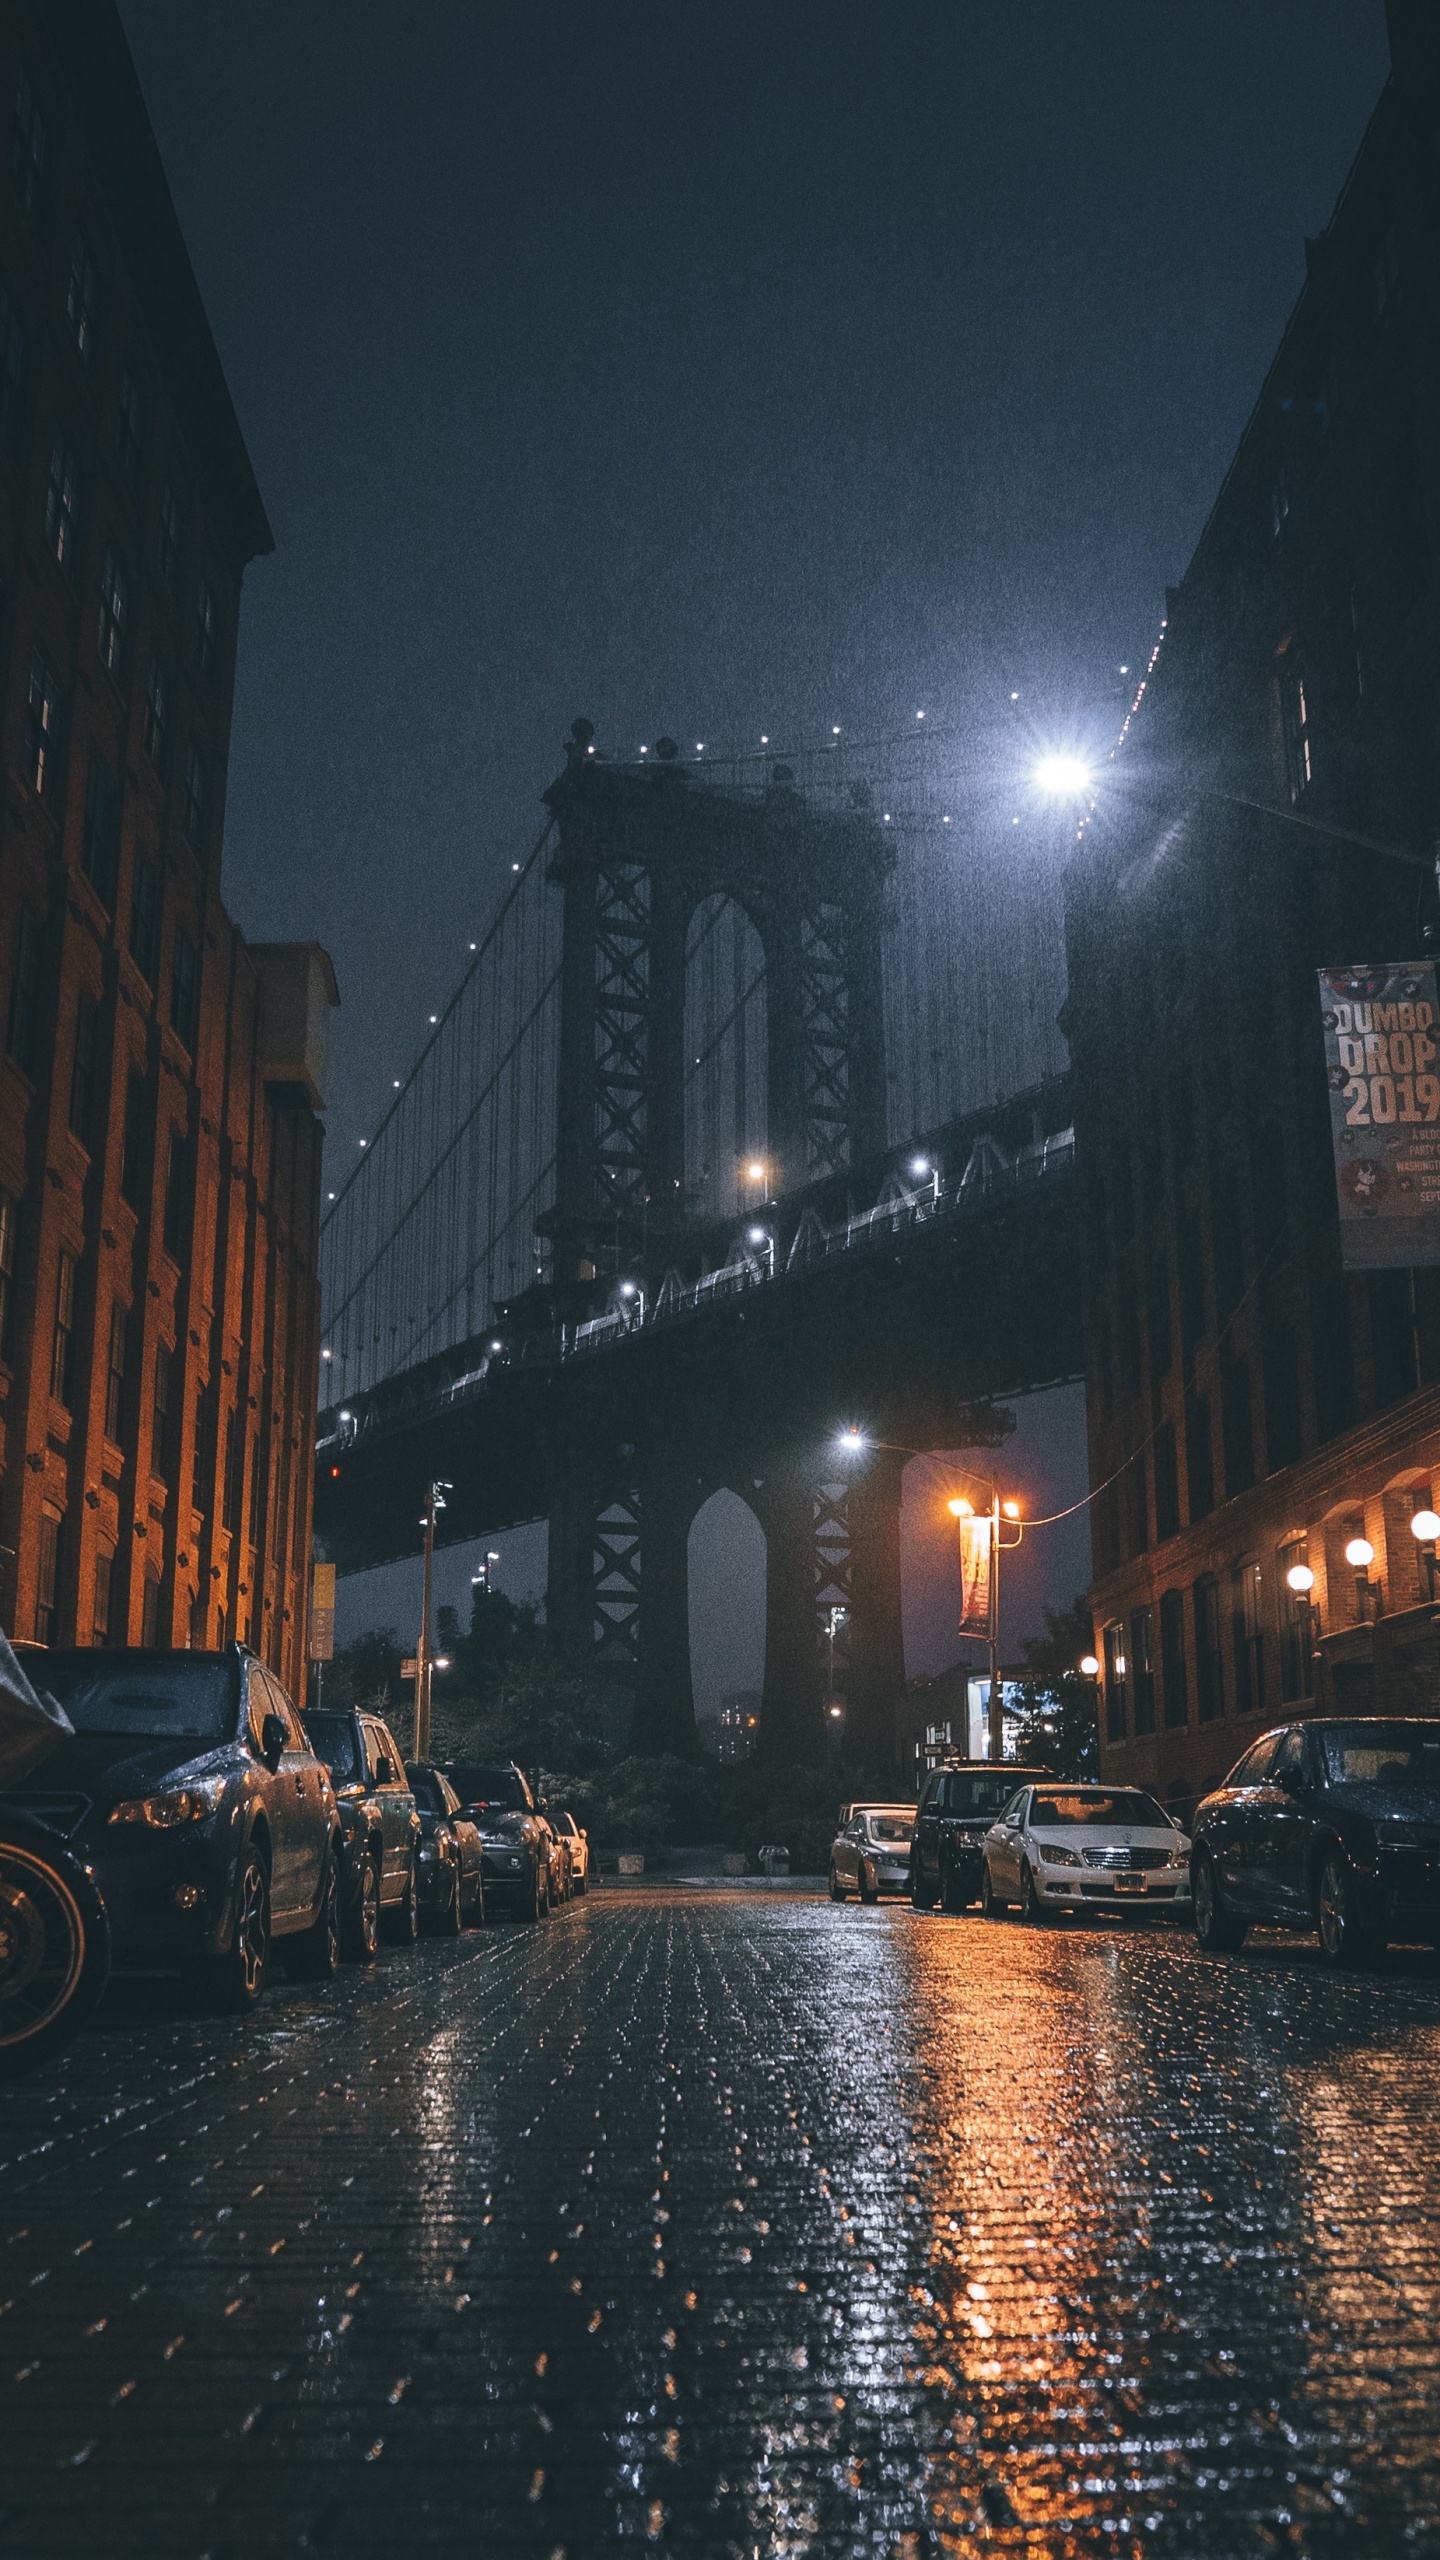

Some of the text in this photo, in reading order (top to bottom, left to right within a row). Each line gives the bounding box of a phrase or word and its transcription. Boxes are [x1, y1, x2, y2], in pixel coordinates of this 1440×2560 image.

[1333, 1001, 1434, 1034] DUMBO
[1338, 1032, 1436, 1076] DROP
[1343, 1074, 1440, 1125] 2019
[1396, 1160, 1440, 1173] WASHINGT
[1409, 1144, 1435, 1157] PARTY
[316, 1611, 326, 1657] Mellon
